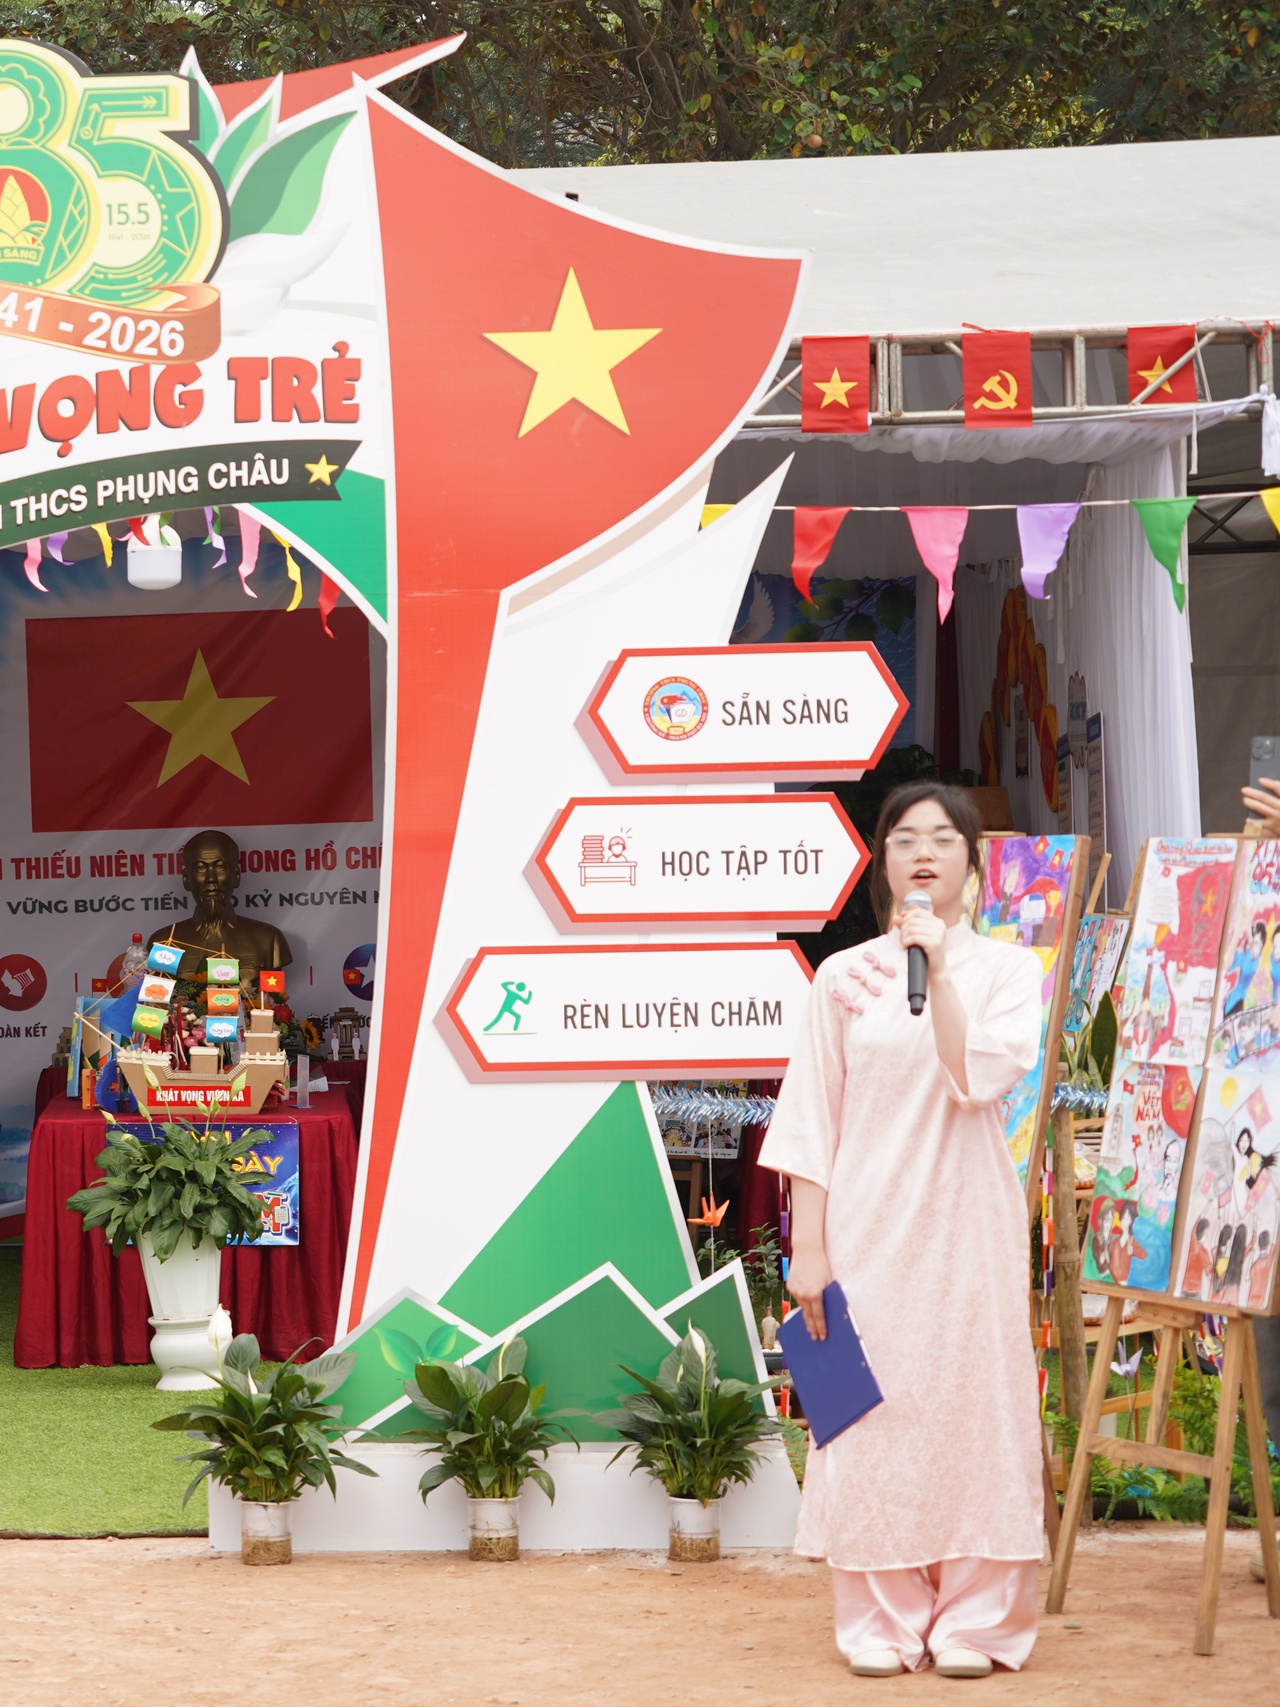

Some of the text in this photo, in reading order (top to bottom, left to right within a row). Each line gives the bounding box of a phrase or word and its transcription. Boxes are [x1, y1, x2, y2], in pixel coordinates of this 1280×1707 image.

[106, 203, 150, 226] 15.5
[82, 311, 185, 357] 2026
[226, 342, 362, 424] TRẺ
[10, 478, 89, 526] THCS
[96, 465, 200, 507] PHỤNG
[206, 456, 291, 489] CHÂU
[722, 692, 848, 726] SẴN SÀNG
[11, 849, 81, 880] THIẾU
[90, 850, 145, 878] NIÊN
[238, 848, 296, 873] HONG
[305, 840, 337, 870] HỒ
[662, 840, 824, 882] HỌC TẬP TỐT
[7, 897, 68, 915] VỮNG
[74, 895, 135, 914] BƯỚC
[141, 892, 188, 911] TIẾN
[245, 888, 273, 908] KỶ
[279, 888, 367, 907] NGUYÊN
[25, 1022, 47, 1038] KẾT
[563, 996, 782, 1033] RÈN LUYỆN CHĂM
[156, 1088, 179, 1102] KHÁT
[180, 1090, 205, 1104] VỌNG
